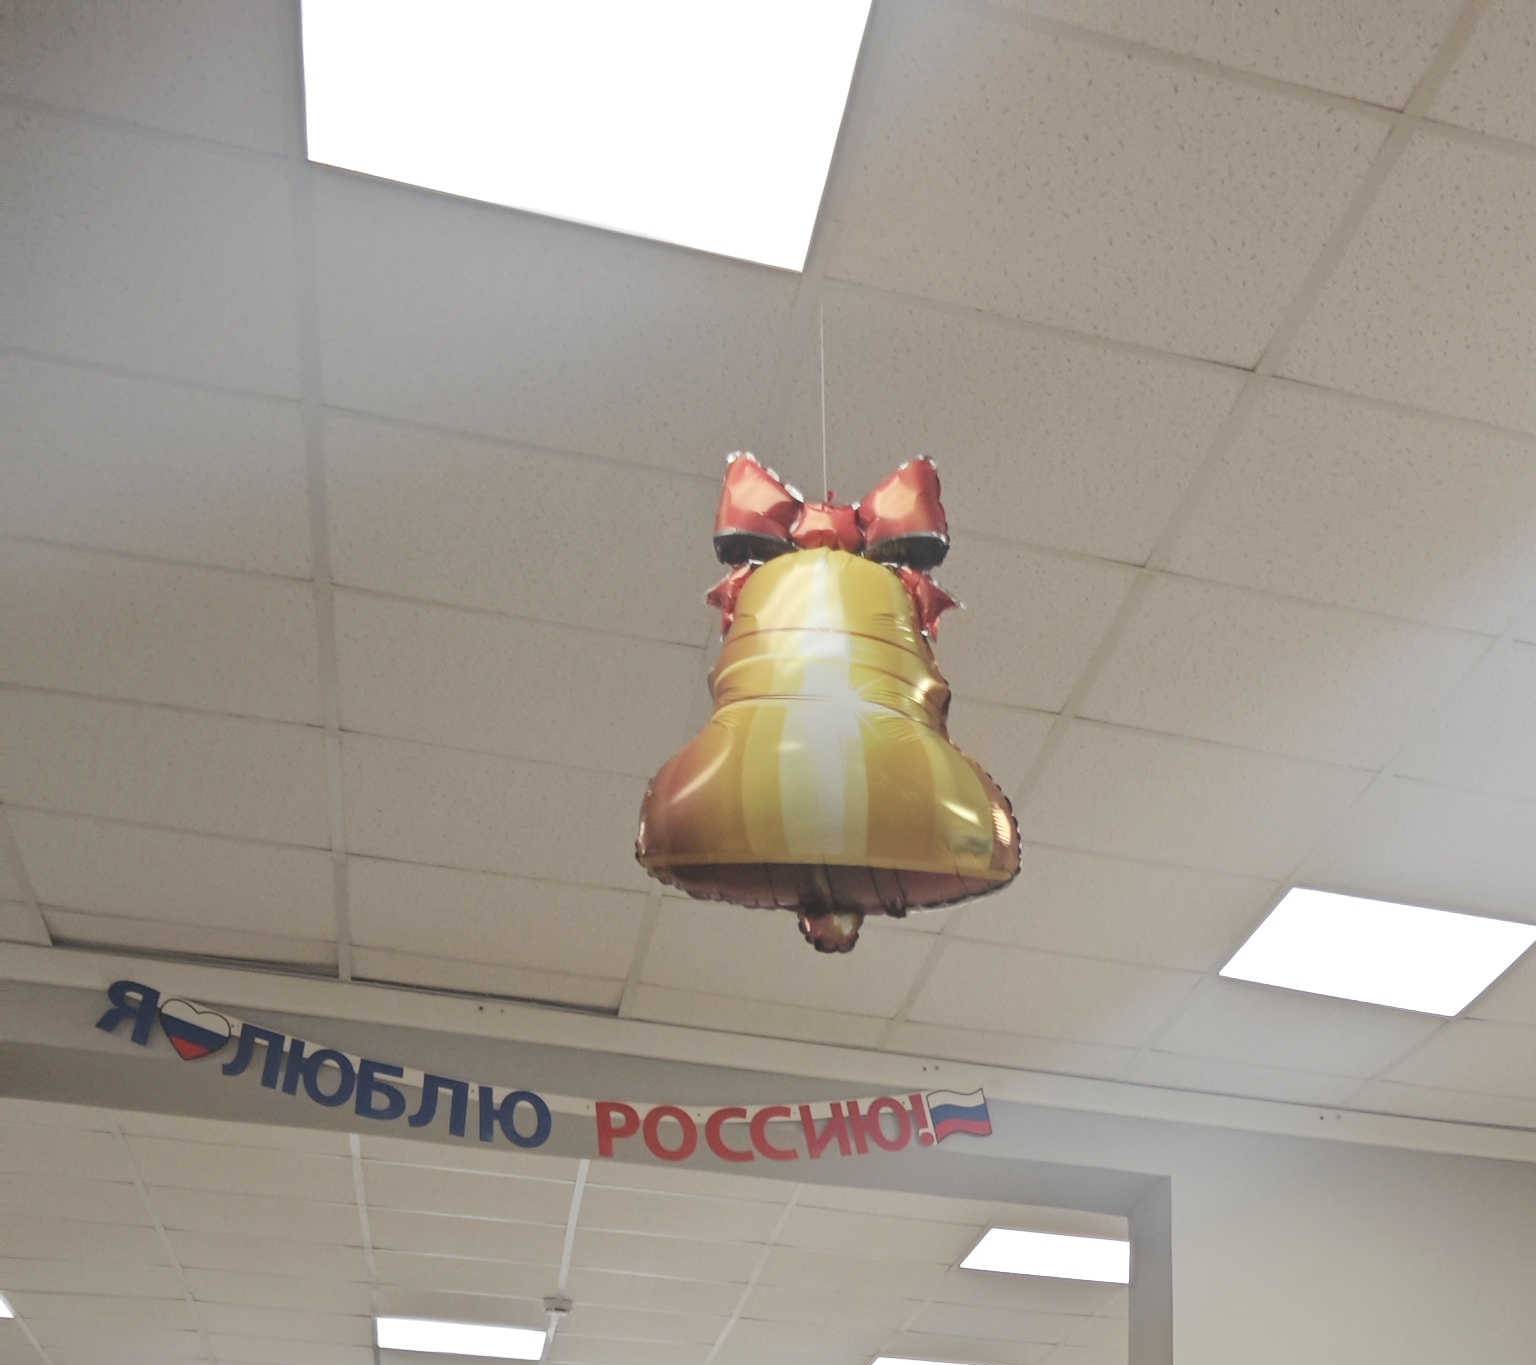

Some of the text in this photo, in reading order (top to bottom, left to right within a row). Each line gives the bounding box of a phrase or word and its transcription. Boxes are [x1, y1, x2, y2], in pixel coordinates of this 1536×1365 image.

[95, 980, 934, 1162] Я ЛЮБЛЮ РОССИЮ!
